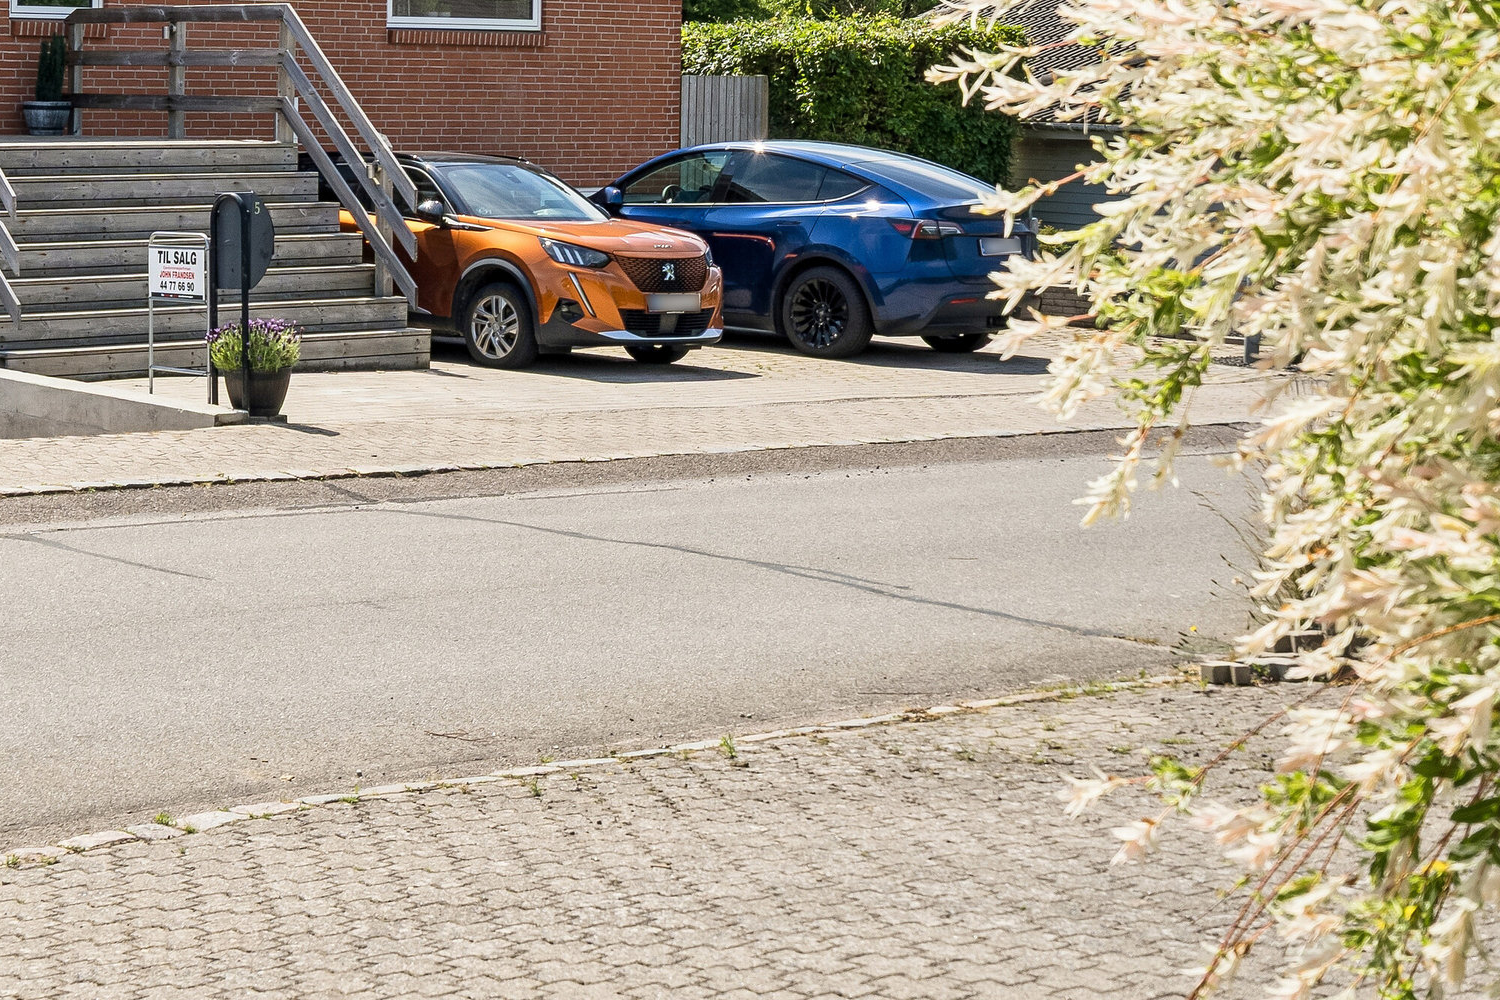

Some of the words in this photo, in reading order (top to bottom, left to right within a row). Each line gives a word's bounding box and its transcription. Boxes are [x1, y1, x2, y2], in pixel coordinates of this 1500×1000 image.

[254, 201, 260, 215] 5
[158, 251, 171, 264] TIL
[173, 251, 197, 265] SALG
[160, 281, 167, 290] 44
[169, 281, 176, 290] 77
[178, 282, 185, 291] 66
[187, 282, 195, 292] 90
